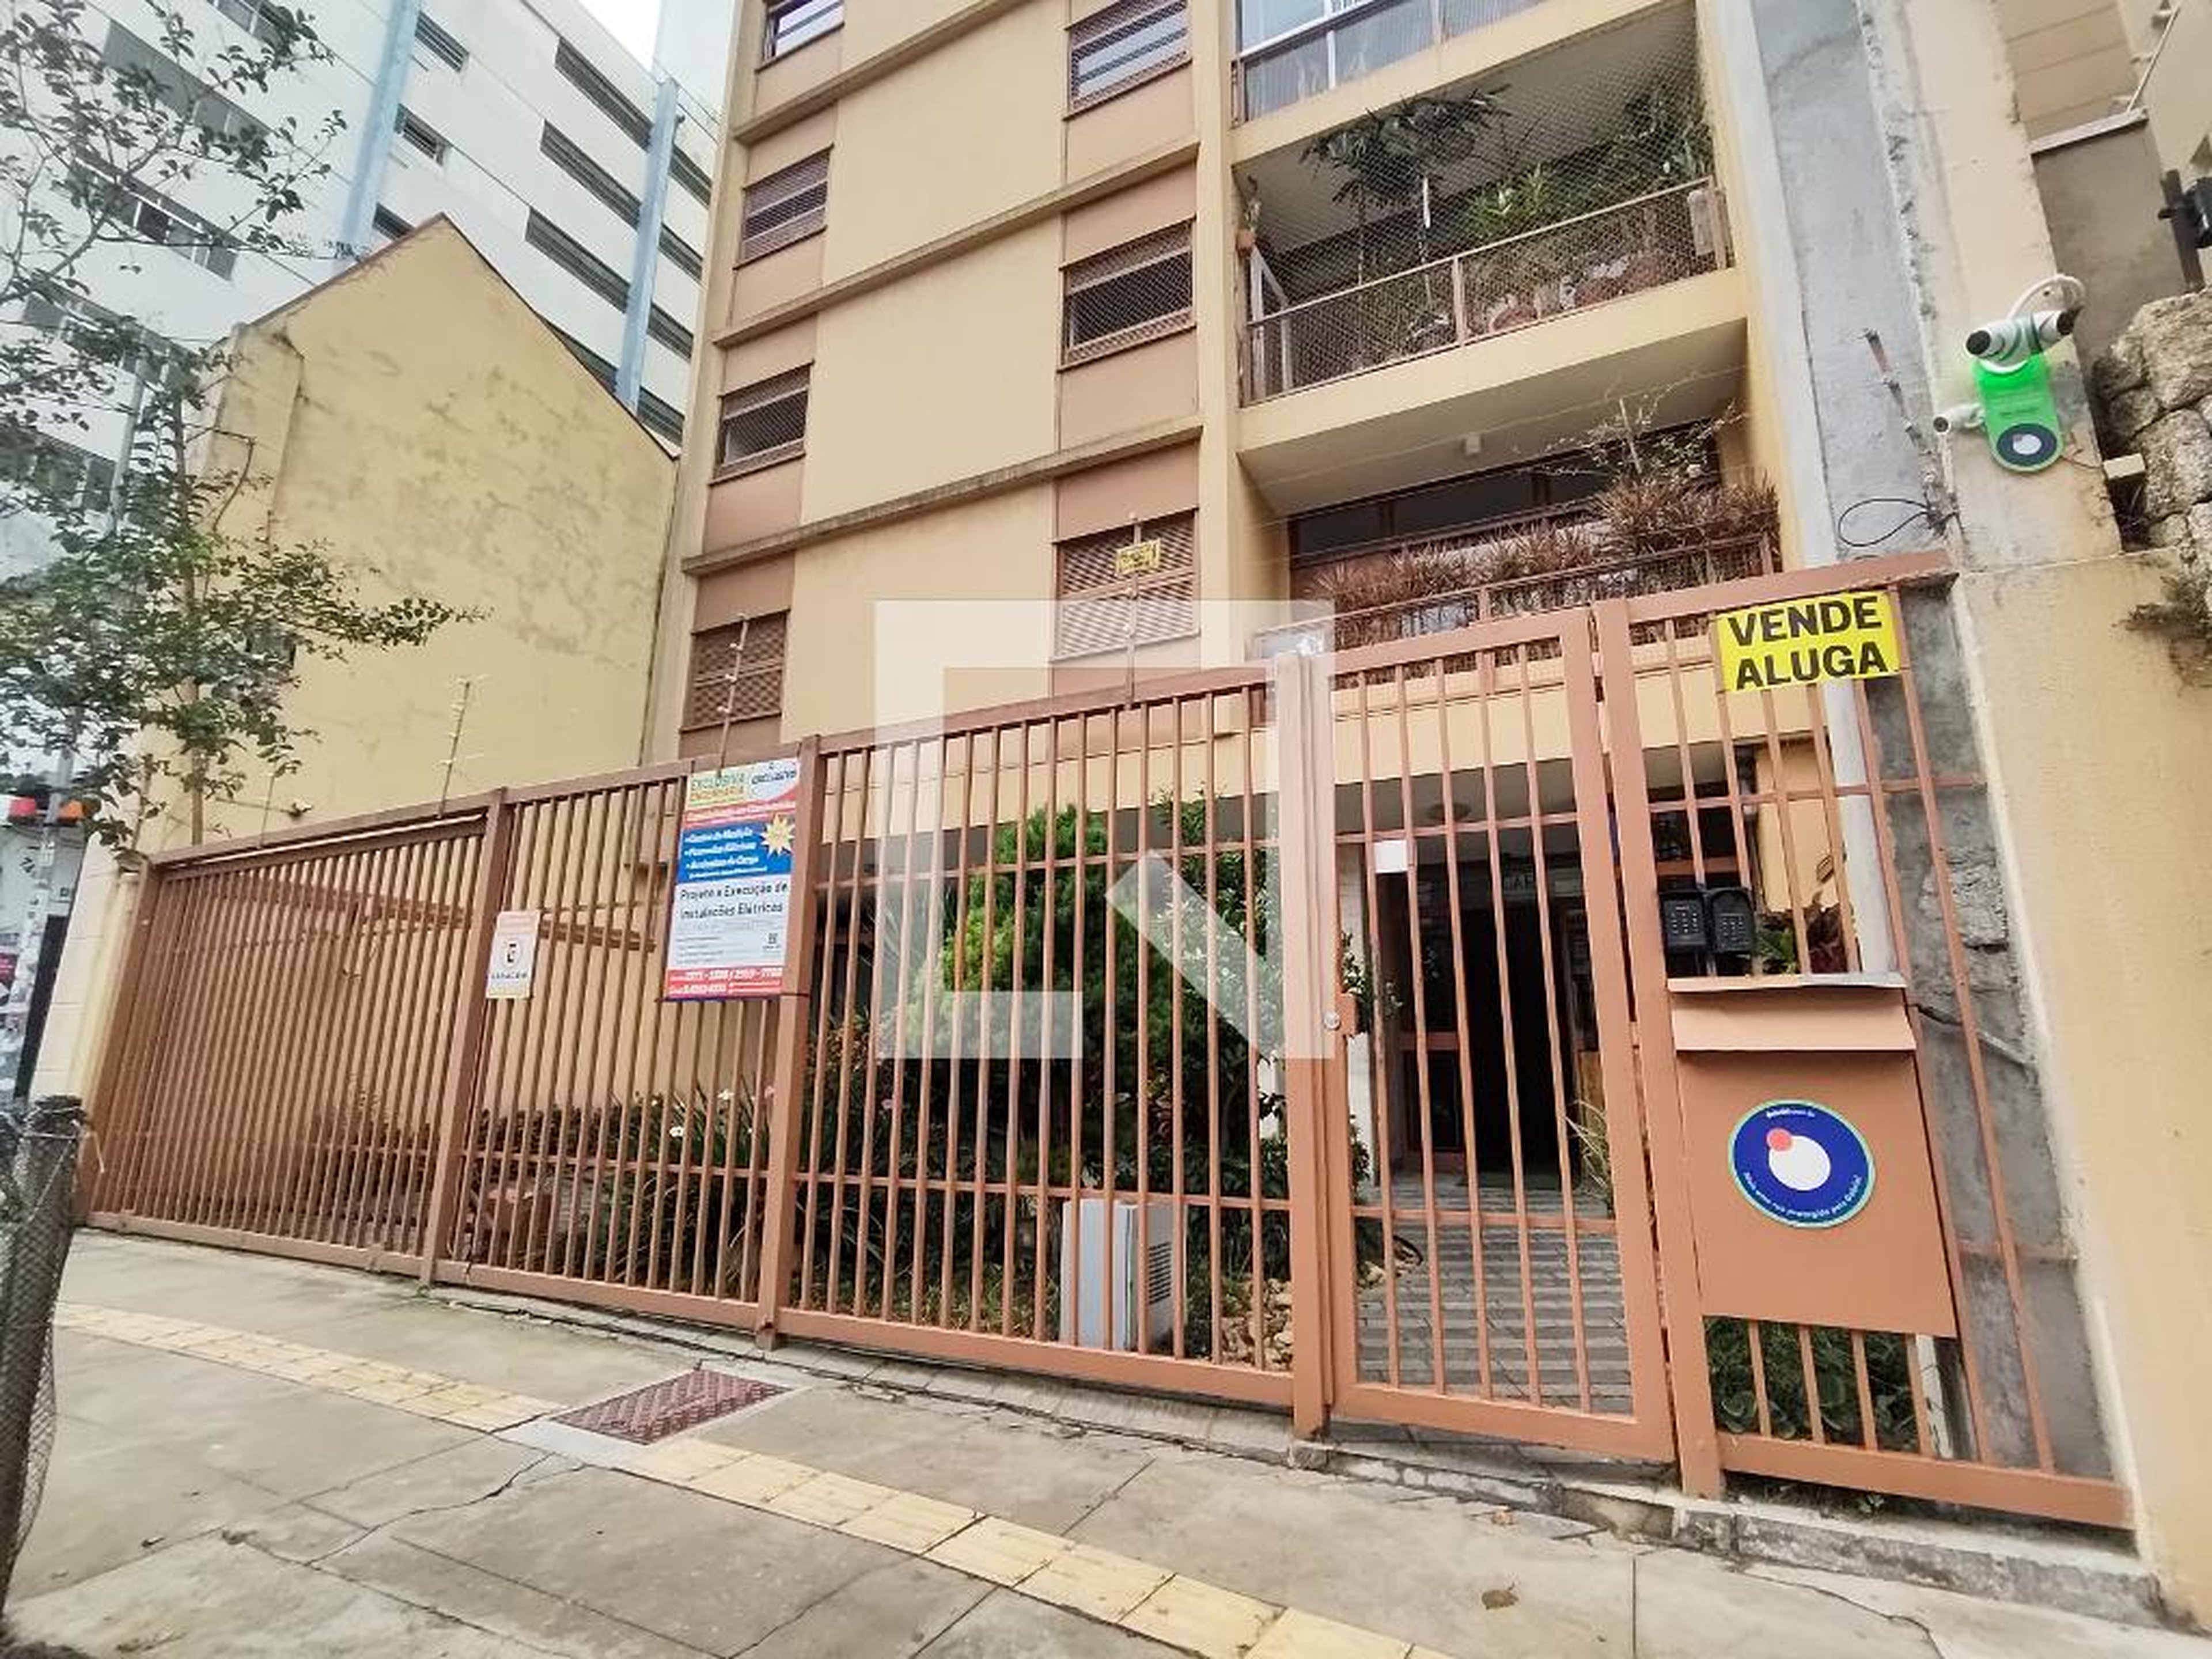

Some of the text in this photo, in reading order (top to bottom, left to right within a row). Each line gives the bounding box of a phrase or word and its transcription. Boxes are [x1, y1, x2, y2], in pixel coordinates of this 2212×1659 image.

[1728, 596, 1882, 646] VENDE
[1736, 641, 1888, 690] ALUGA
[680, 888, 714, 901] Projeto
[724, 882, 772, 897] Execução
[774, 881, 787, 892] de
